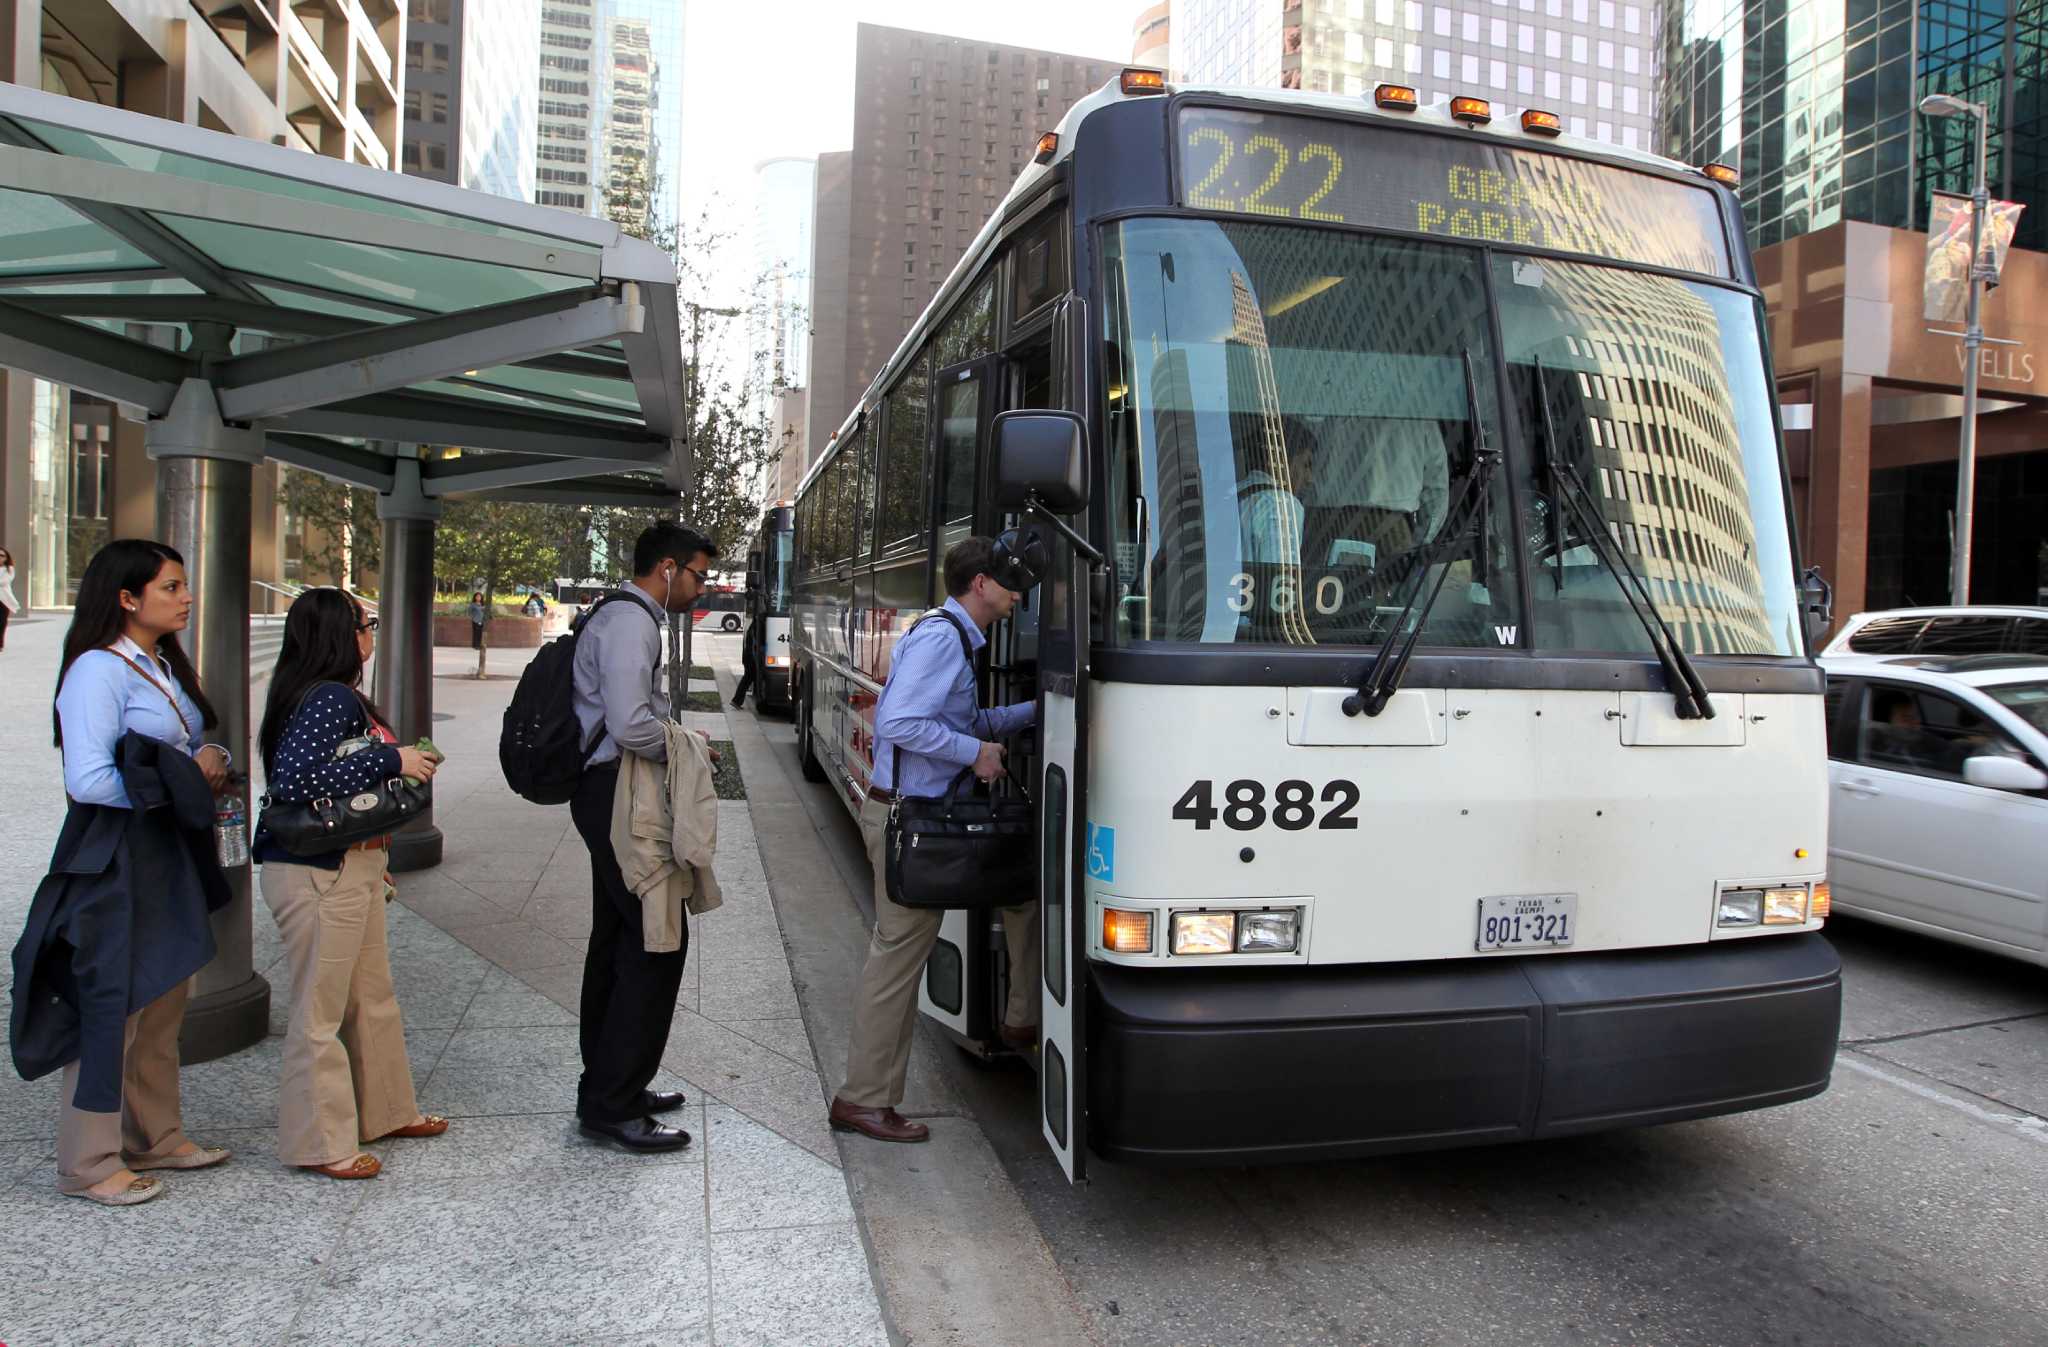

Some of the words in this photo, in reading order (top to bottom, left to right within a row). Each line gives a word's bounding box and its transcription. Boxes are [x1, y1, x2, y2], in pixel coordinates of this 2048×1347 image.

[1188, 127, 1344, 222] 222
[1448, 164, 1601, 220] GRAND
[1226, 573, 1344, 615] 360
[1494, 625, 1517, 645] W
[1172, 779, 1361, 831] 4882
